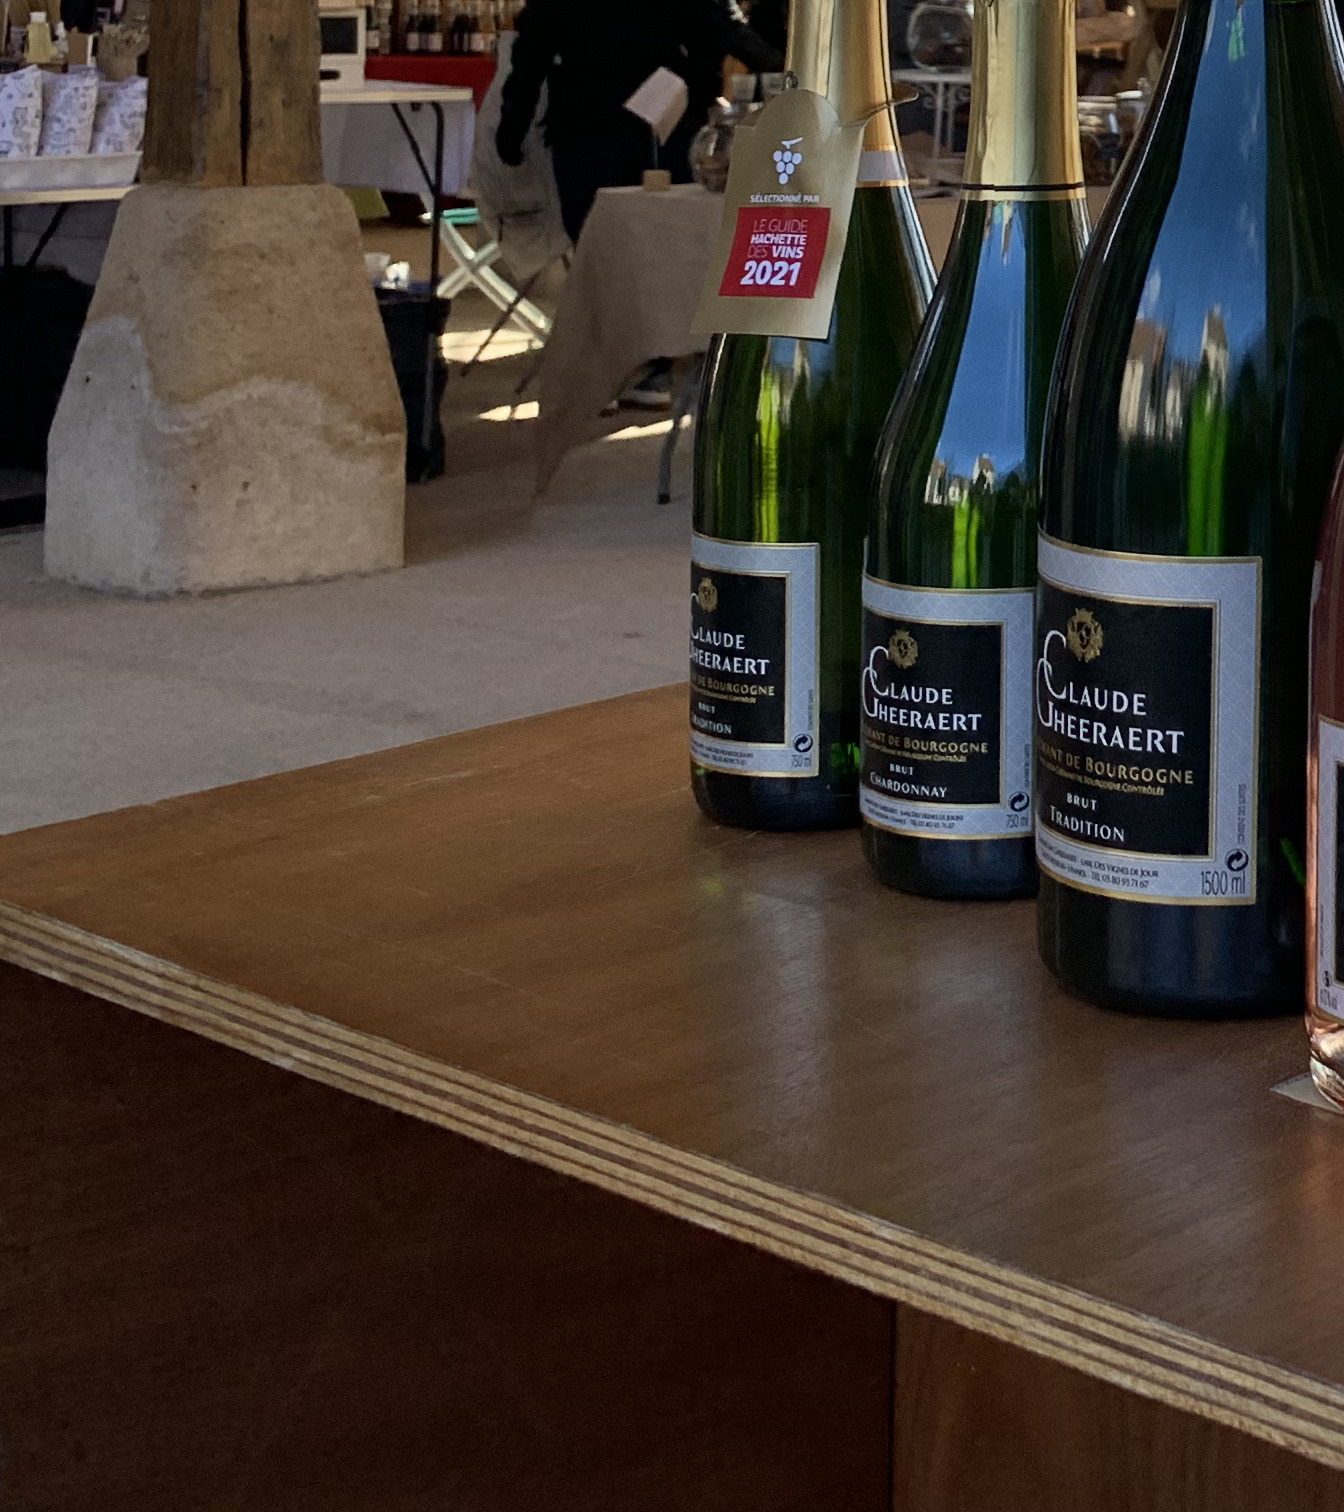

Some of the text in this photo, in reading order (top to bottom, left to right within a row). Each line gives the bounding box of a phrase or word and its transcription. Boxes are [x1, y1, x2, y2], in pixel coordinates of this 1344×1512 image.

[750, 192, 820, 203] SÉLECTIONNÉ PAR
[753, 219, 809, 233] LE GUIDE
[750, 234, 808, 246] HACHETTE
[747, 245, 805, 259] DES VINS
[740, 260, 802, 286] 2021
[869, 645, 954, 705] CLAUDE
[1044, 630, 1147, 716] CLAUDE
[708, 678, 775, 696] BOURGOGNE
[862, 666, 982, 731] GHEERAERT
[1036, 657, 1185, 754] GHEERAERT
[904, 738, 989, 754] BOURGOGNE
[889, 762, 914, 775] BRUT
[1066, 754, 1081, 770] DE
[1086, 756, 1194, 785] BOURGOGNE
[870, 771, 947, 798] CHARDONNAY
[1067, 792, 1097, 811] BRUT
[1006, 814, 1020, 828] 750
[1050, 805, 1125, 842] TRADITION
[1200, 870, 1246, 896] 1500 ml
